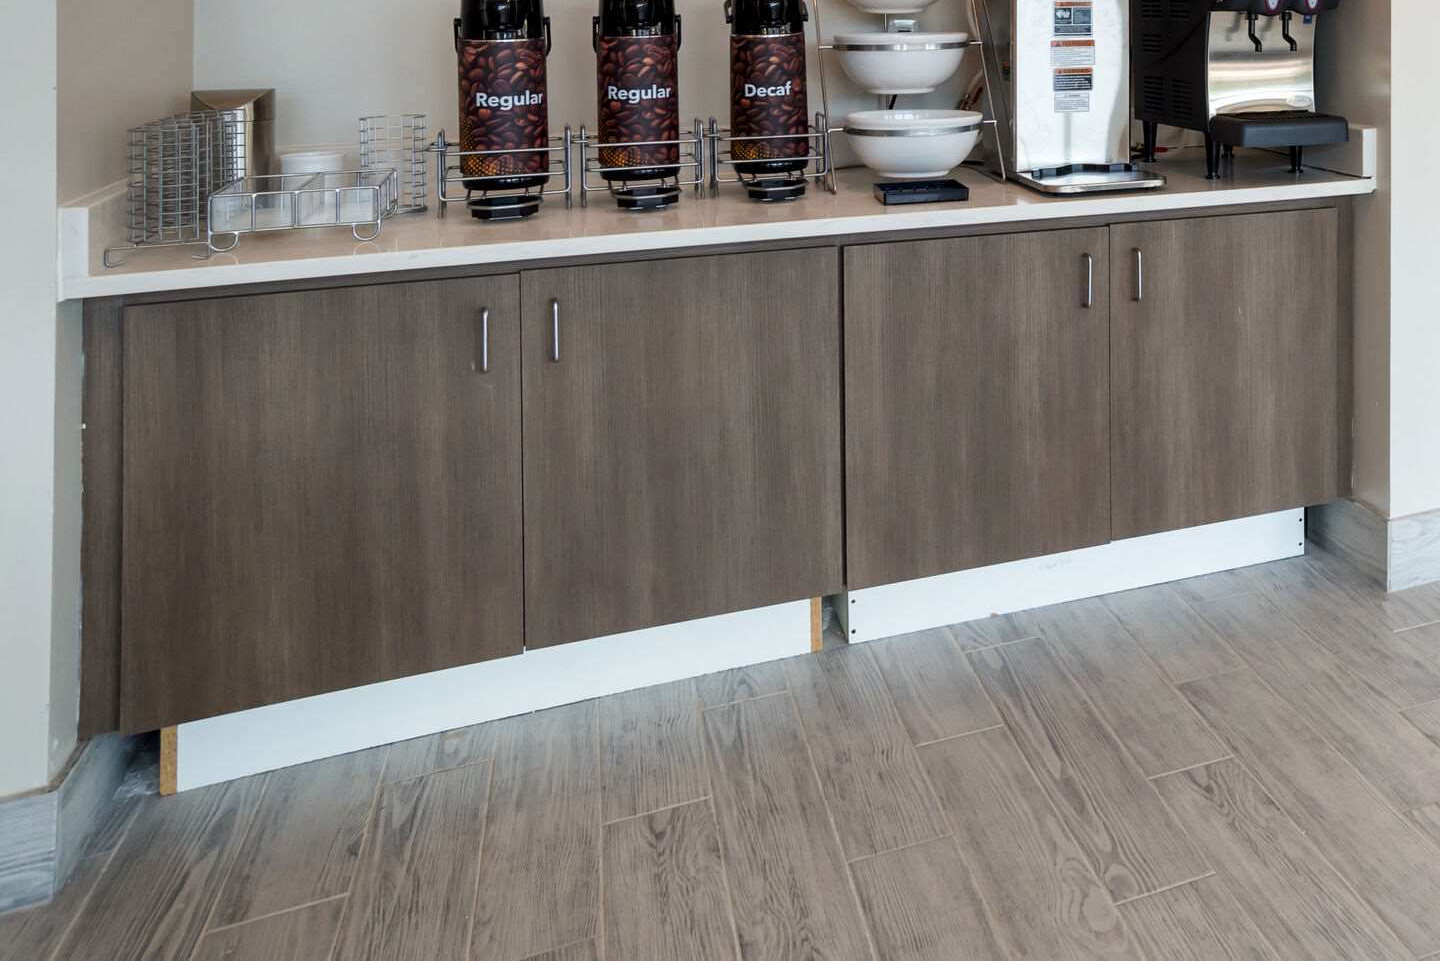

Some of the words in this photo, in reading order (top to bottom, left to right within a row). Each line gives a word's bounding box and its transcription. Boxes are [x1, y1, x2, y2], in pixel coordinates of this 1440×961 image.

[607, 85, 672, 104] Regular
[744, 80, 792, 98] Decaf
[476, 92, 543, 111] Regular
